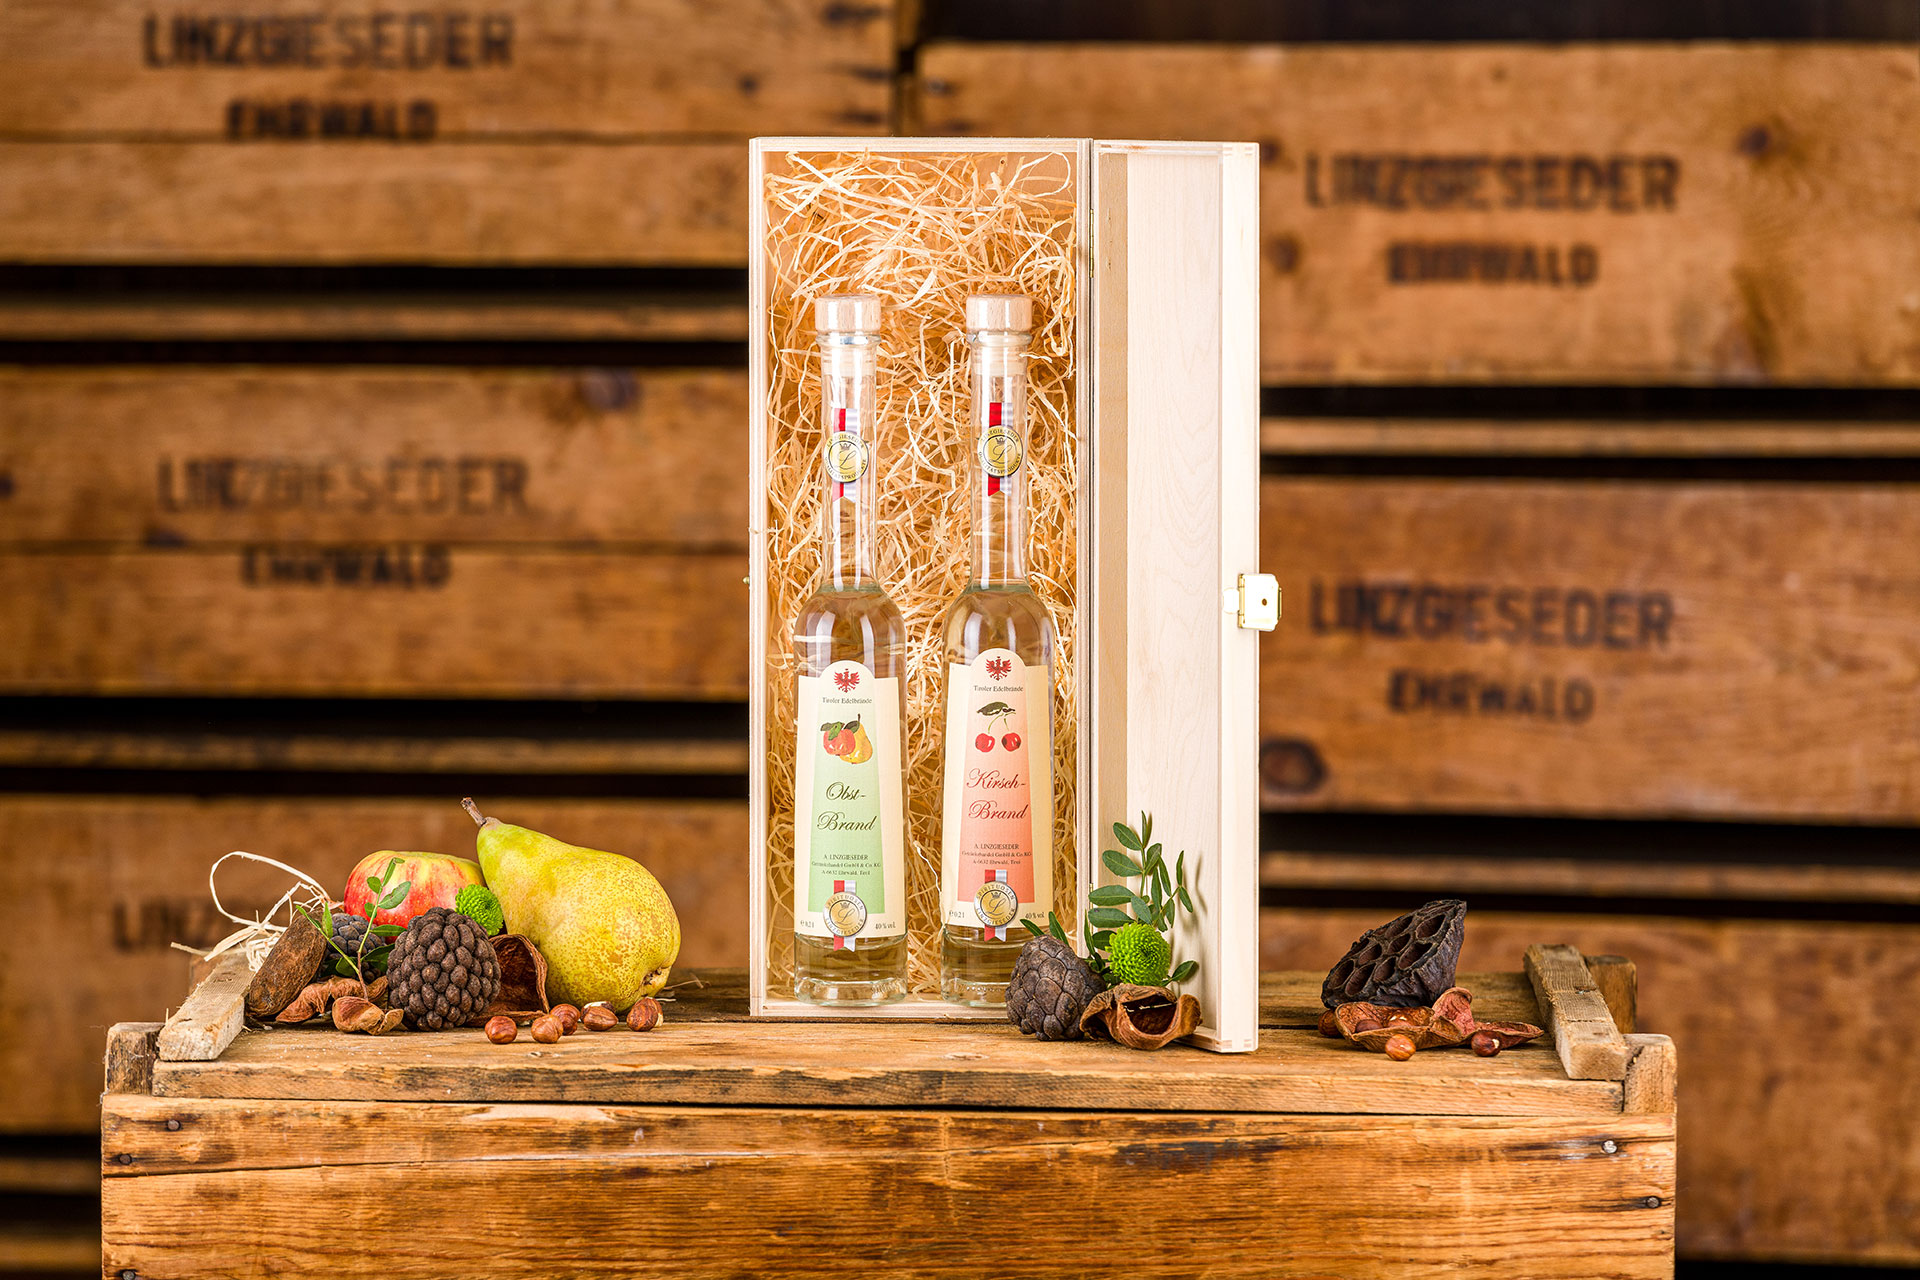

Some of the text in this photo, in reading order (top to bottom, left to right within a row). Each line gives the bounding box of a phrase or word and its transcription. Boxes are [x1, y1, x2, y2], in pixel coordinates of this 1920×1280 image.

[144, 12, 513, 69] LINZGIESEDER
[1304, 151, 1680, 213] LINZGIESEDER
[159, 454, 529, 514] LINZGIESEDER
[1309, 575, 1676, 650] LINZGIESEDER
[825, 781, 866, 800] Obst-
[966, 767, 1026, 789] Kirsch-
[817, 810, 878, 831] Brand
[968, 799, 1029, 819] Brand
